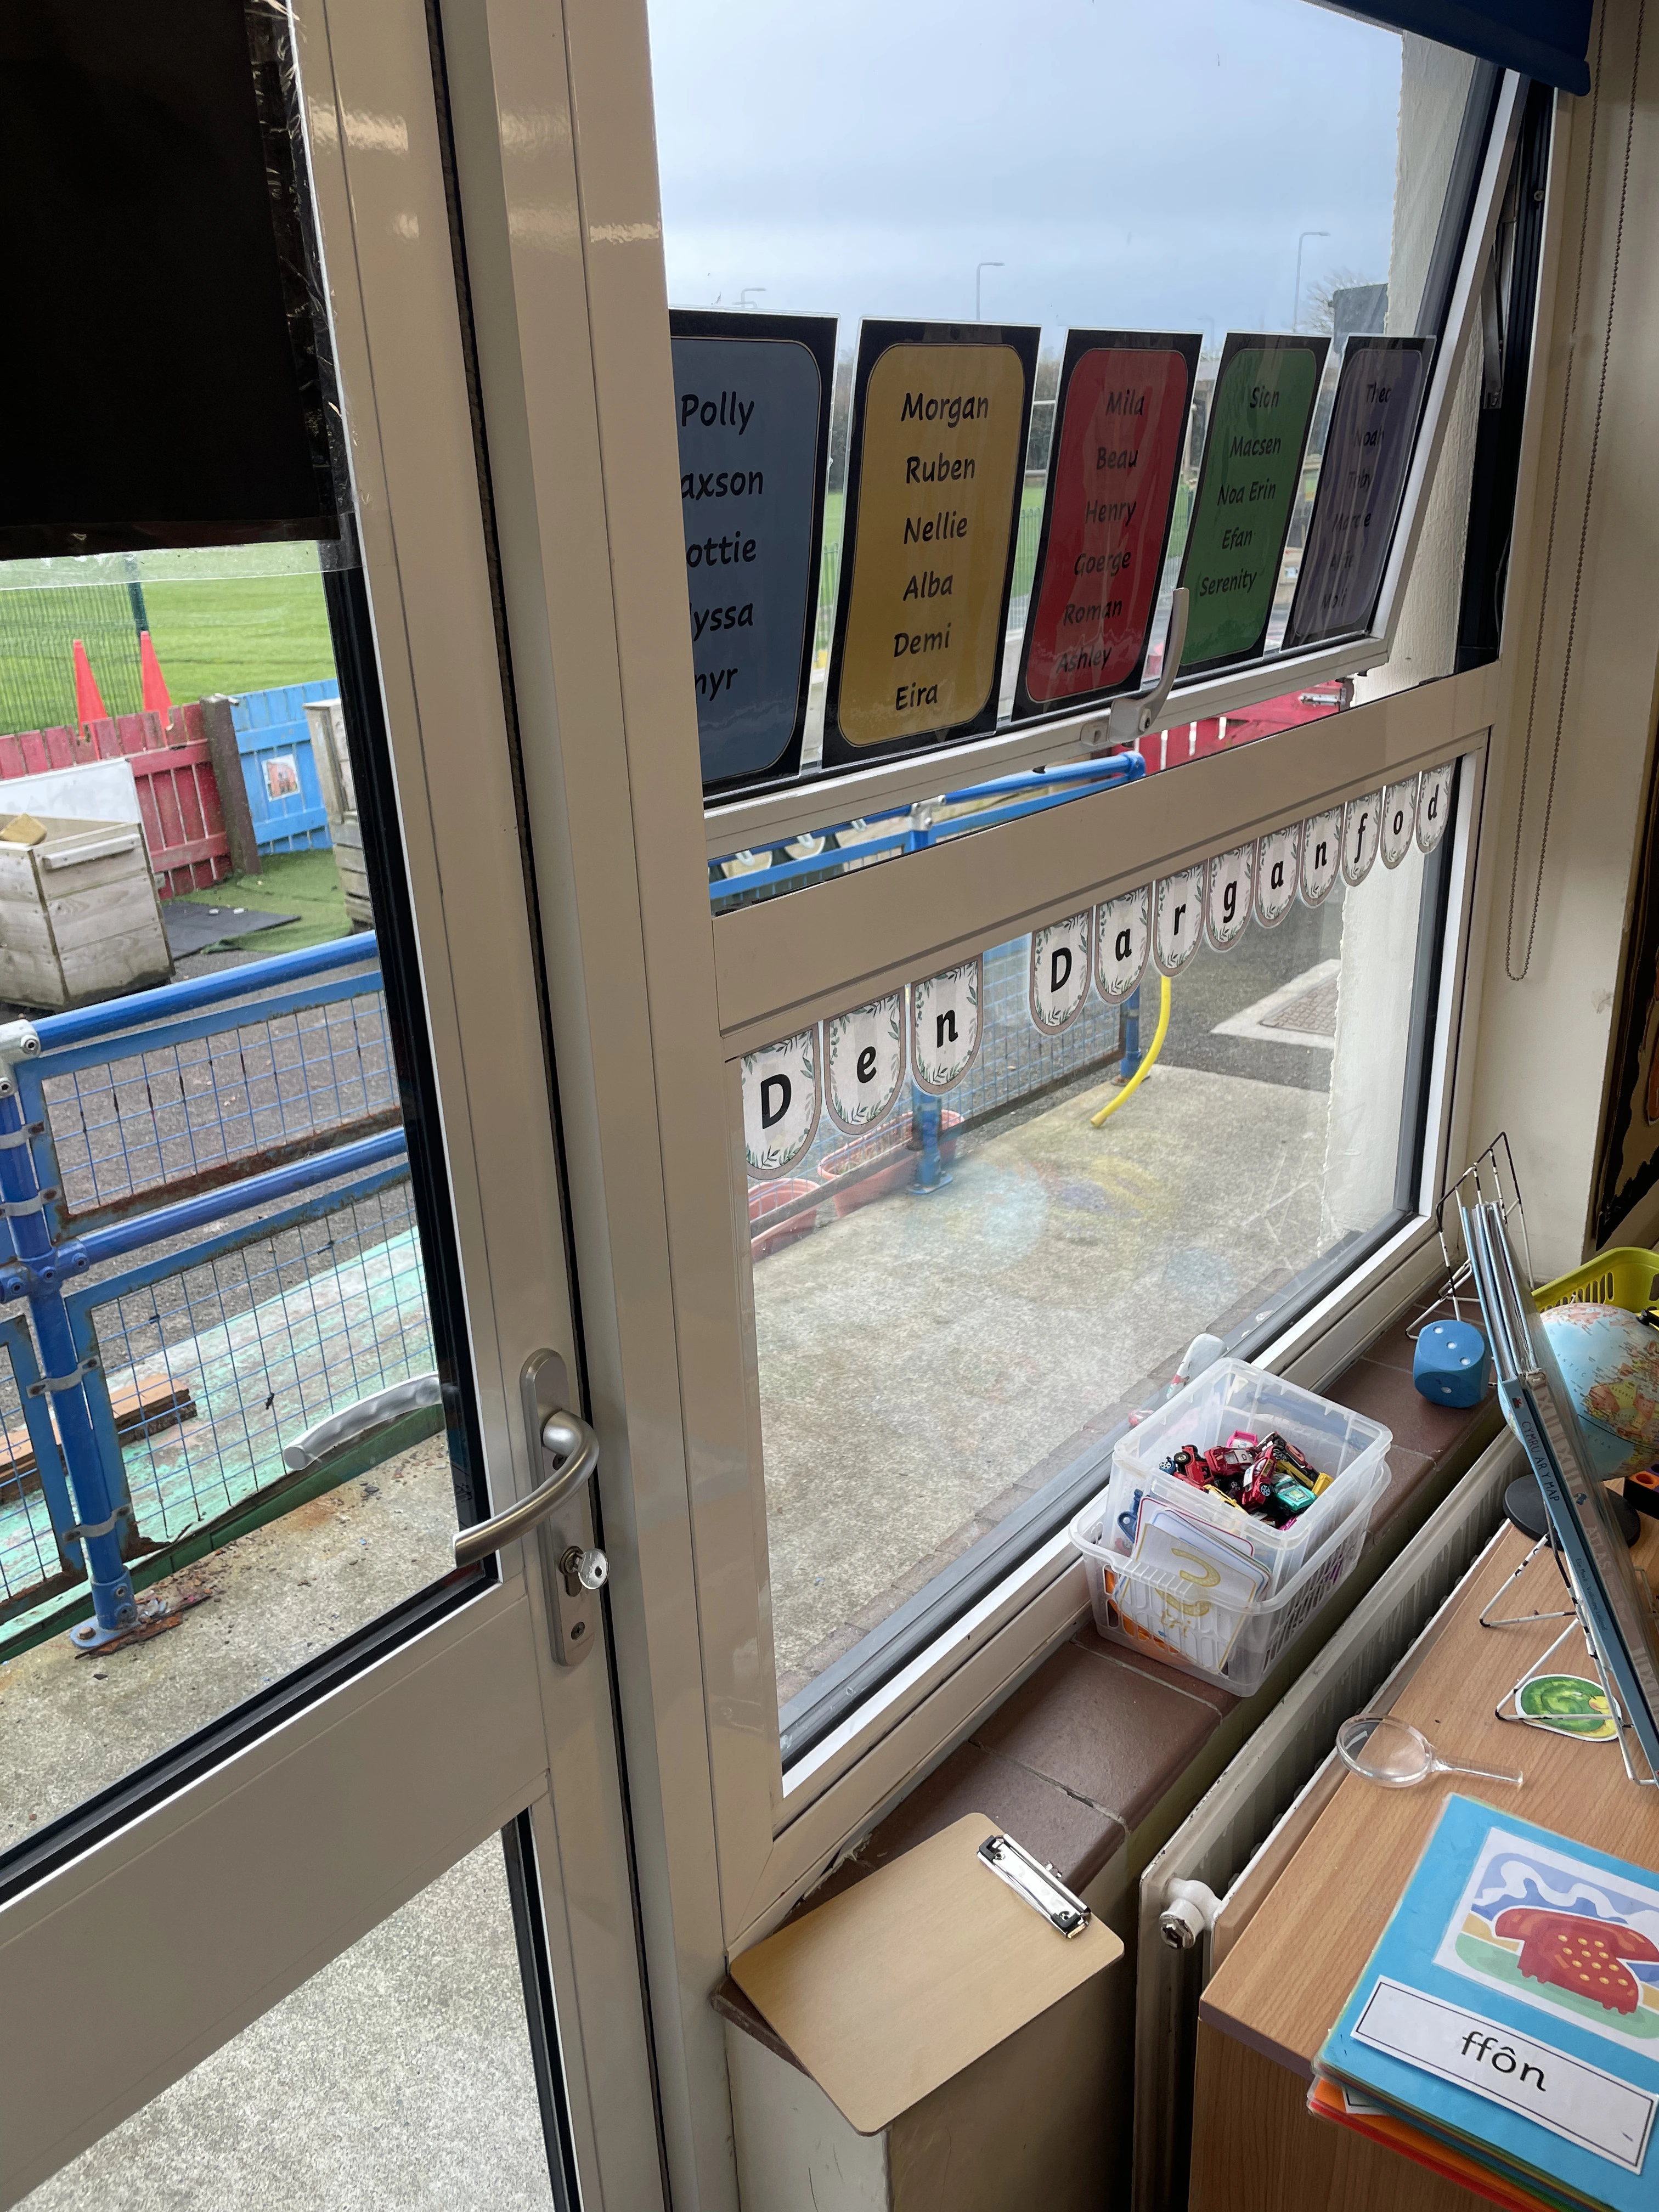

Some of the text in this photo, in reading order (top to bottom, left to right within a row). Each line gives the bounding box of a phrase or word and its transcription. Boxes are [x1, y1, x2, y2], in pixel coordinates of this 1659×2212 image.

[900, 392, 989, 428] Morgan
[1105, 389, 1145, 416] Mila
[1249, 385, 1280, 409] Sion
[681, 391, 754, 435] Polly
[1097, 446, 1138, 470] Beau
[1229, 436, 1282, 459] Macsen
[906, 455, 976, 484] Ruben
[681, 471, 763, 500] axson
[1217, 478, 1276, 506] Noa Erin
[904, 511, 968, 545] Nellie
[1085, 500, 1137, 527] Henry
[686, 531, 757, 568] ottie
[1222, 527, 1252, 551] Efan
[1074, 551, 1131, 577] Goerge
[902, 571, 953, 602] Alba
[1199, 568, 1257, 597] Serenity
[690, 602, 753, 642] yssa
[1063, 600, 1122, 626] Roman
[893, 623, 952, 658] Demi
[1056, 644, 1112, 674] Ashley
[895, 681, 938, 711] Eira
[760, 785, 1440, 1130] Den Darganfod
[1521, 1421, 1541, 1453] CYMRU
[1534, 1457, 1547, 1470] AR
[1544, 1481, 1560, 1502] MAP
[1461, 2031, 1547, 2092] ffôn
